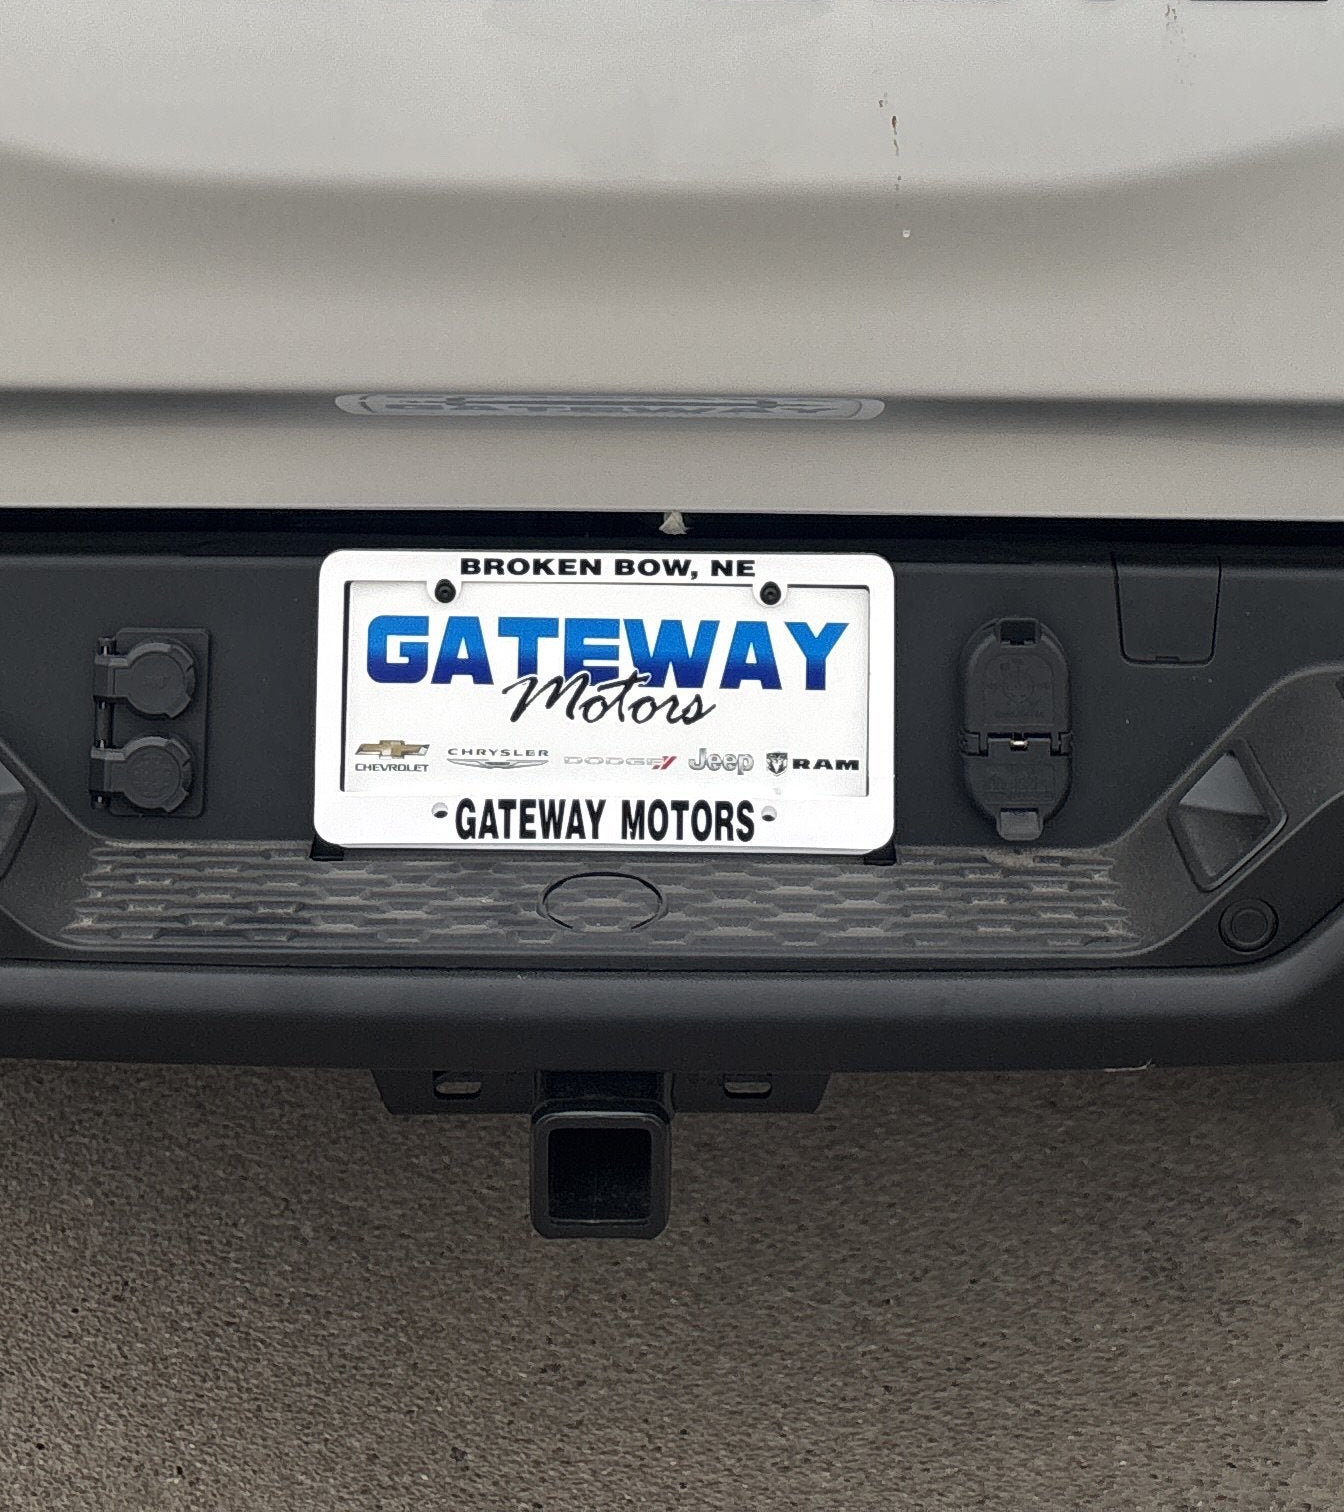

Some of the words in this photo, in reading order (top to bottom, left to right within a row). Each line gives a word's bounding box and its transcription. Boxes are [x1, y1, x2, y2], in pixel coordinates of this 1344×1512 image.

[460, 557, 602, 576] BROKEN
[614, 558, 698, 580] BOW,
[711, 560, 756, 578] NE
[366, 615, 850, 691] GATEWAY
[501, 670, 717, 726] Motors
[447, 747, 550, 758] CHRYSLER
[563, 755, 664, 768] DODGE
[688, 747, 755, 776] Jeep
[354, 762, 430, 773] CHEVROLET
[792, 757, 861, 772] RAM
[455, 797, 607, 841] GATEWAY
[621, 799, 755, 843] MOTORS
